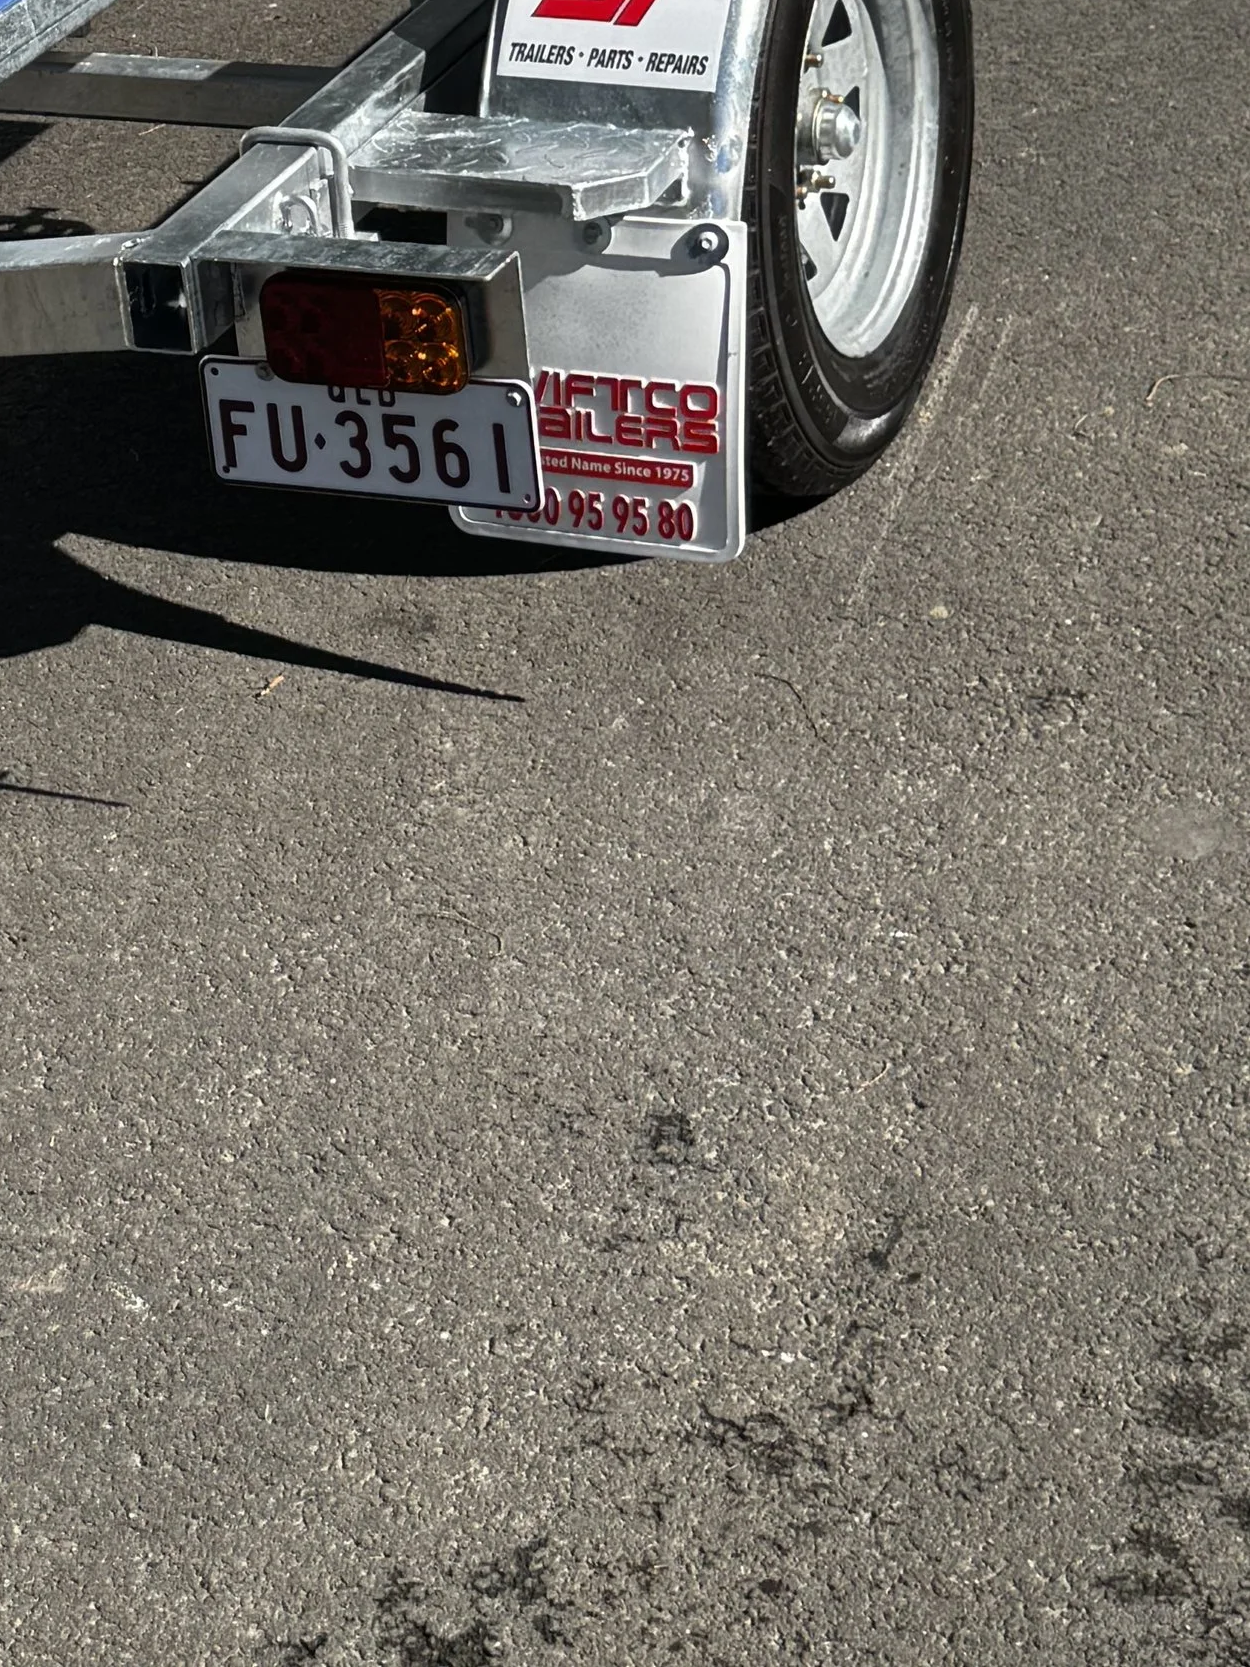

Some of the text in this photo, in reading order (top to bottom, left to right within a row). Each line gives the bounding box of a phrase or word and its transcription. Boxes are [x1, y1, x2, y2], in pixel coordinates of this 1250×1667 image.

[508, 42, 709, 76] TRAILERS PARTS REPAIRS
[536, 368, 721, 421] IFTCO
[538, 405, 720, 454] AILERS
[571, 457, 611, 473] Name
[614, 461, 651, 478] Since
[655, 466, 690, 482] 1975
[568, 489, 604, 531] 95
[612, 494, 650, 536] 95
[658, 499, 697, 542] 80
